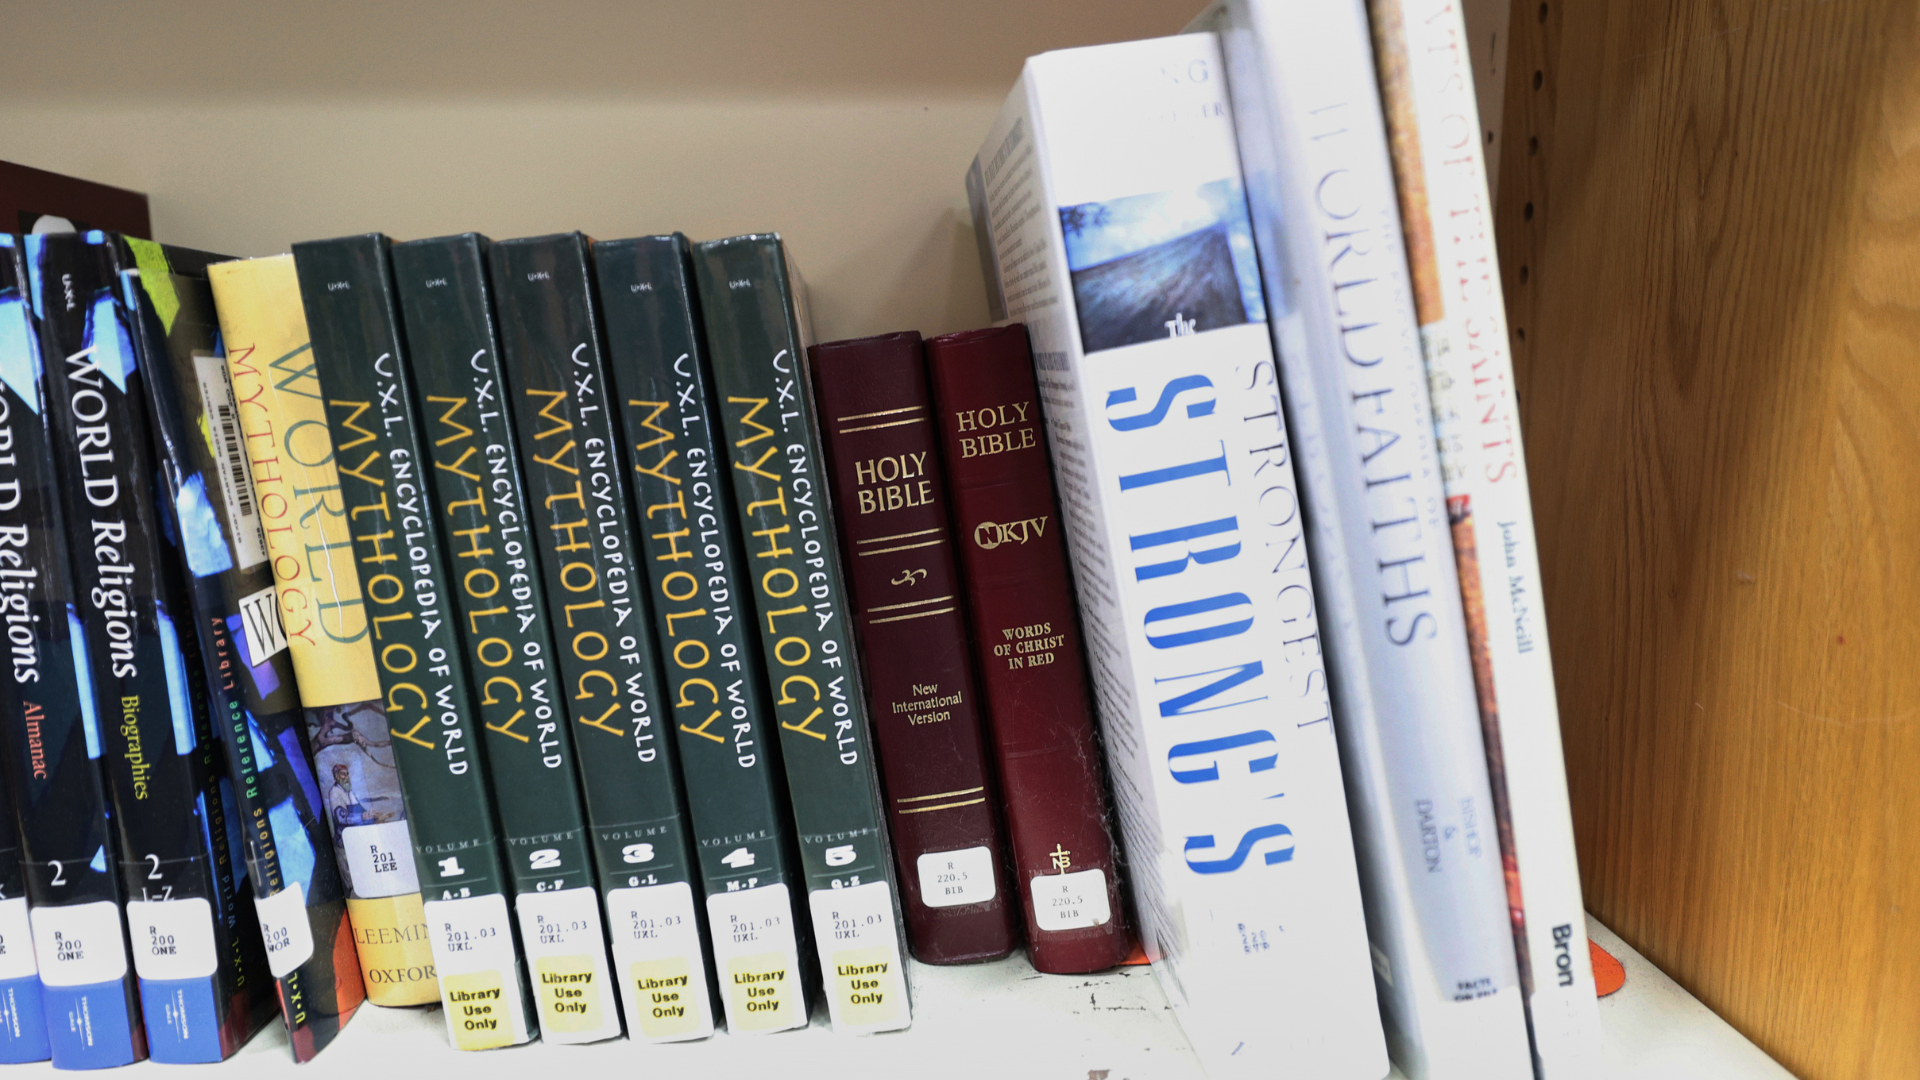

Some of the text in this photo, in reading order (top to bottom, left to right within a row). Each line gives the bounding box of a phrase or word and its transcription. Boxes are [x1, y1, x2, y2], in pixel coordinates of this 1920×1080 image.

[1164, 312, 1197, 339] The
[956, 401, 1030, 432] HOLY
[959, 427, 1036, 459] BIBLE
[855, 451, 928, 485] HOLY
[228, 343, 316, 646] MYTHOLOGY
[268, 342, 369, 644] WORLD
[857, 480, 935, 515] BIBLE
[66, 345, 138, 679] WORLD Religions
[1351, 388, 1438, 647] FAITHS
[974, 515, 1049, 550] NKJV
[572, 343, 657, 762] U.X.L. ENCYCLOPEDIA OF WORLD
[1236, 360, 1333, 735] STRONGEST
[374, 352, 469, 776] U.X.L. ENCYCLOPEDIA OF WORLD
[471, 349, 562, 768] U.X.L. ENCYCLOPEDIA OF WORLD
[526, 388, 625, 737] MYTHOLOGY
[674, 353, 756, 768] U.X.L. ENCYCLOPEDIA OF WORLD
[773, 349, 858, 765] U.X.L. ENCYCLOPEDIA OF WORLD
[329, 399, 435, 750] MYTHOLOGY
[427, 395, 530, 743] MYTHOLOGY
[628, 399, 725, 744] MYTHOLOGY
[727, 396, 827, 742] MYTHOLOGY
[1497, 520, 1536, 656] John McNeill
[1002, 622, 1052, 641] WORDS
[1105, 374, 1296, 875] STRONG'S
[993, 634, 1065, 656] OF CHRIST
[211, 616, 235, 691] Library
[1008, 652, 1055, 670] IN RED
[912, 683, 938, 697] New
[891, 691, 963, 714] International
[907, 710, 951, 726] Version
[23, 700, 47, 781] Almanac
[120, 694, 151, 801] Biographies
[228, 699, 258, 799] Reference
[509, 831, 574, 846] VOLUME
[602, 826, 667, 841] VOLUME
[701, 829, 766, 847] VOLUME
[804, 827, 869, 845] VOLUME
[1416, 798, 1443, 873] DARTON
[370, 845, 378, 854] R
[415, 838, 480, 853] VOLUME
[372, 852, 396, 864] 201
[529, 849, 562, 870] 2
[622, 843, 655, 864] 3
[721, 847, 755, 868] 4
[825, 844, 857, 867] 5
[48, 860, 67, 887] 2
[144, 853, 163, 880] 2
[374, 862, 398, 873] LEE
[438, 856, 465, 878] 1
[947, 862, 954, 870] R
[628, 874, 658, 887] G-L
[726, 878, 758, 892] M-P
[830, 876, 861, 889] Q-Z
[936, 872, 968, 883] 220.5
[536, 879, 564, 892] C-F
[944, 886, 964, 896] BIB
[1062, 885, 1069, 893] R
[442, 887, 471, 901] A-B
[1051, 895, 1084, 907] 220.5
[537, 915, 544, 925] R
[631, 911, 638, 920] R
[730, 914, 738, 924] R
[832, 911, 840, 920] R
[1060, 909, 1079, 919] BIB
[263, 924, 270, 933] R
[445, 922, 453, 932] R
[539, 921, 588, 935] 201.03
[633, 915, 682, 930] 201.03
[733, 916, 781, 934] 201.03
[834, 914, 883, 930] 201.03
[54, 931, 63, 941] R
[149, 926, 157, 935] R
[265, 927, 288, 942] 200
[447, 927, 497, 943] 201.03
[633, 930, 658, 940] UXL
[733, 933, 758, 943] UXL
[835, 930, 860, 940] UXL
[57, 940, 82, 951] 200
[152, 935, 175, 946] 200
[267, 939, 291, 954] WOR
[448, 942, 474, 953] UXL
[540, 935, 565, 945] UXL
[57, 950, 84, 962] ONE
[151, 945, 177, 956] ONE
[1552, 923, 1575, 988] Bron
[734, 970, 786, 984] Library
[837, 962, 888, 977] Library
[541, 972, 593, 984] Library
[637, 974, 688, 990] Library
[850, 979, 879, 991] Use
[449, 987, 501, 1002] Library
[554, 987, 582, 999] Use
[652, 991, 680, 1004] Use
[747, 986, 776, 998] Use
[850, 993, 884, 1005] Only
[463, 1004, 492, 1017] Use
[554, 1002, 588, 1014] Only
[652, 1005, 686, 1019] Only
[747, 1000, 780, 1013] Only
[81, 996, 94, 1047] THOMSON
[176, 989, 189, 1040] THOMSON
[464, 1019, 498, 1031] Only
